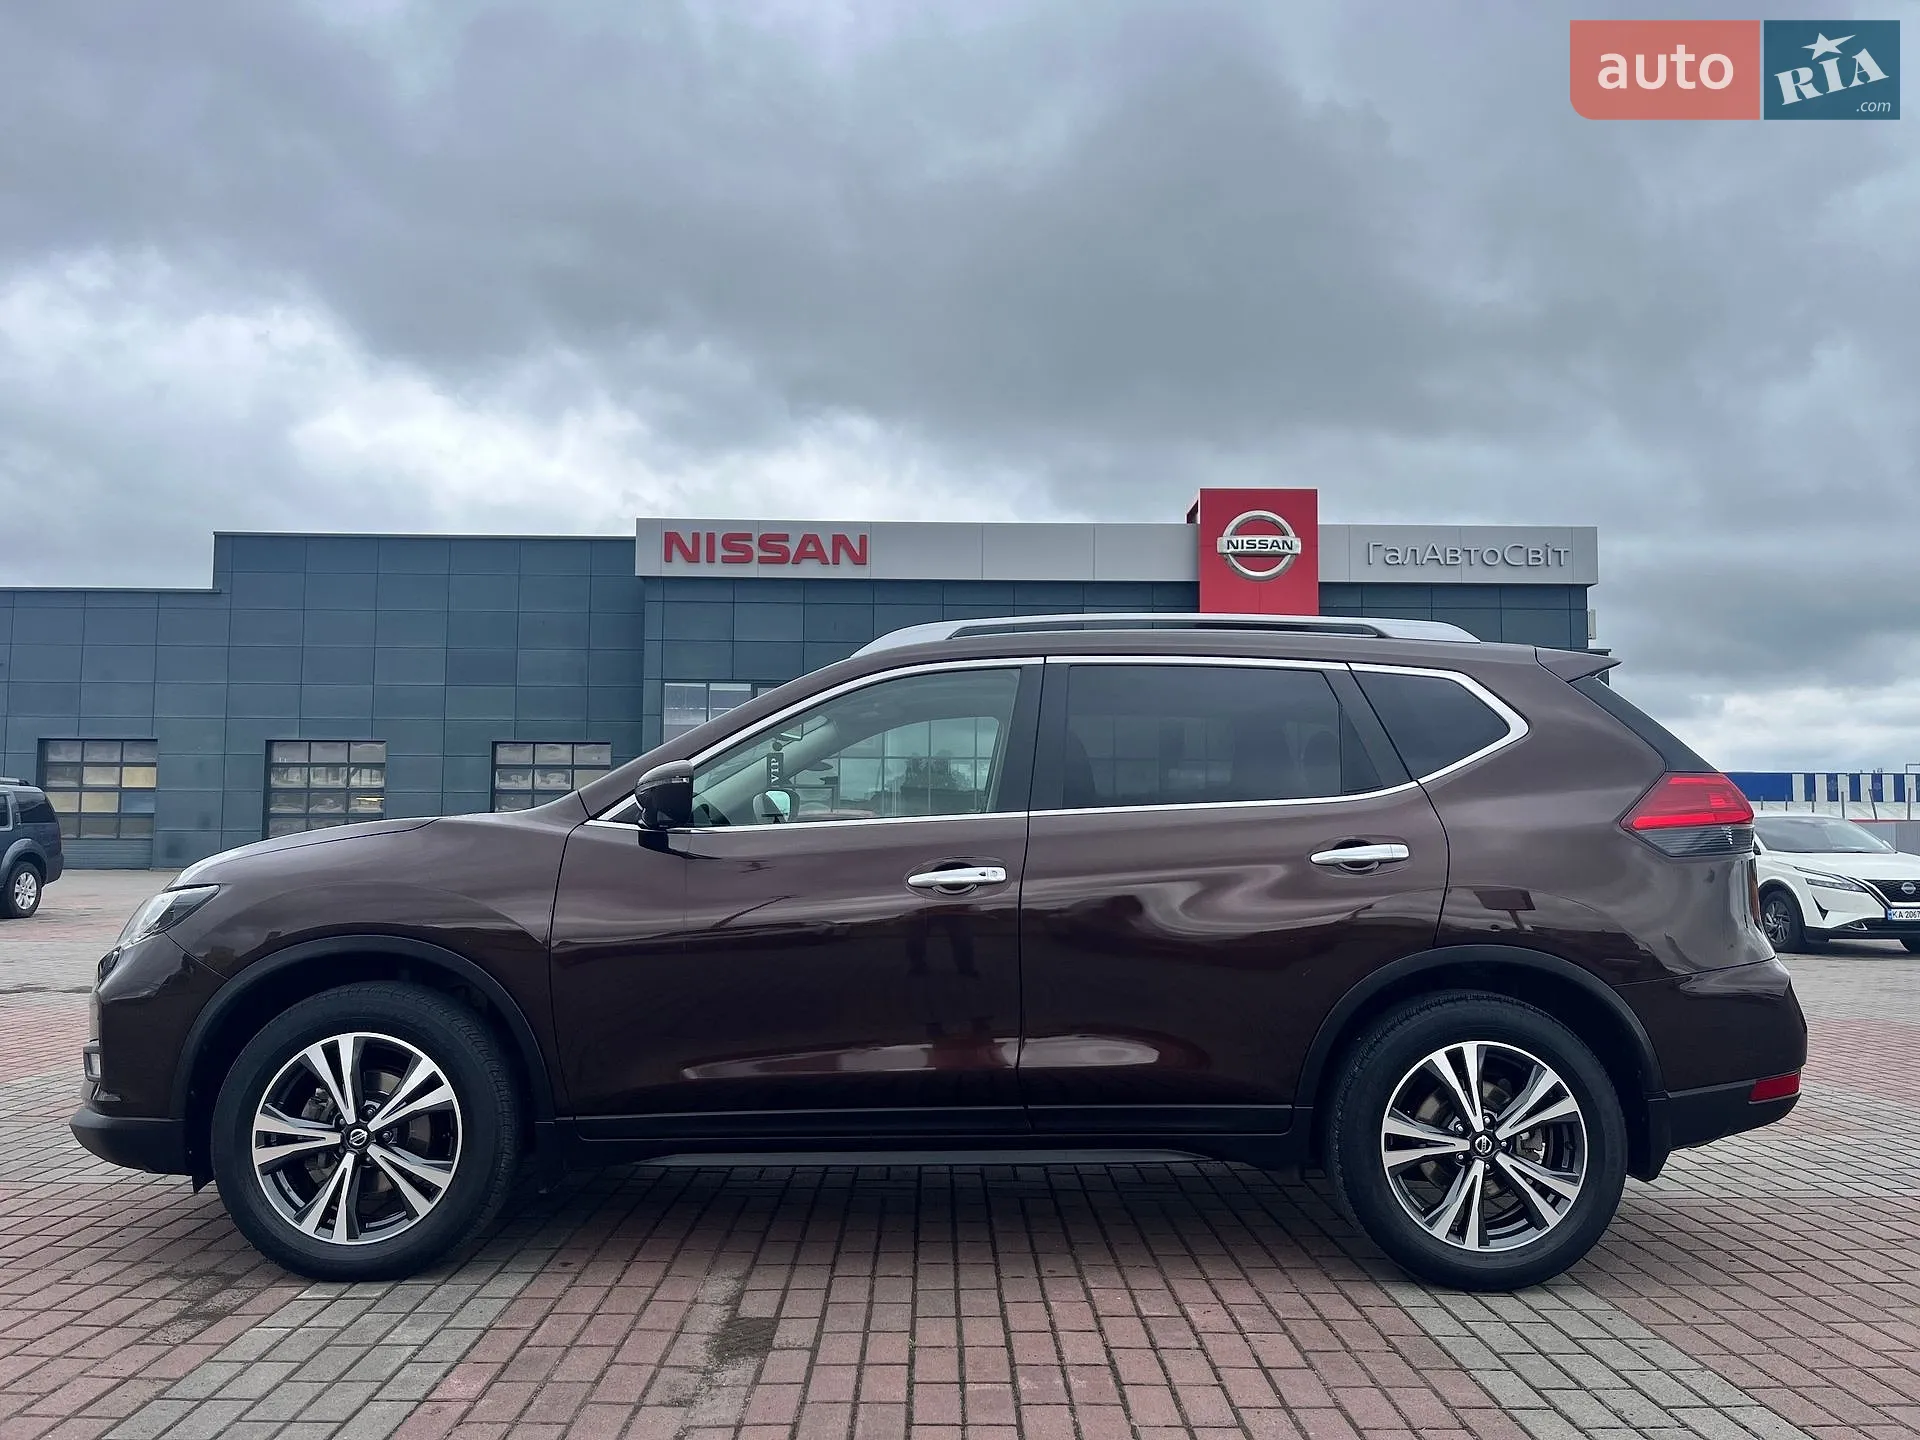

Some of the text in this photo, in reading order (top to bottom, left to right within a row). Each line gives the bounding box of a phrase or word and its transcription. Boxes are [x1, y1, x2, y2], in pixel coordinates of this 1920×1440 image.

[664, 531, 868, 566] NISSAN
[1227, 539, 1293, 551] NISSAN
[1368, 542, 1570, 567] ГалАвтоСвіт
[770, 758, 779, 783] VIP
